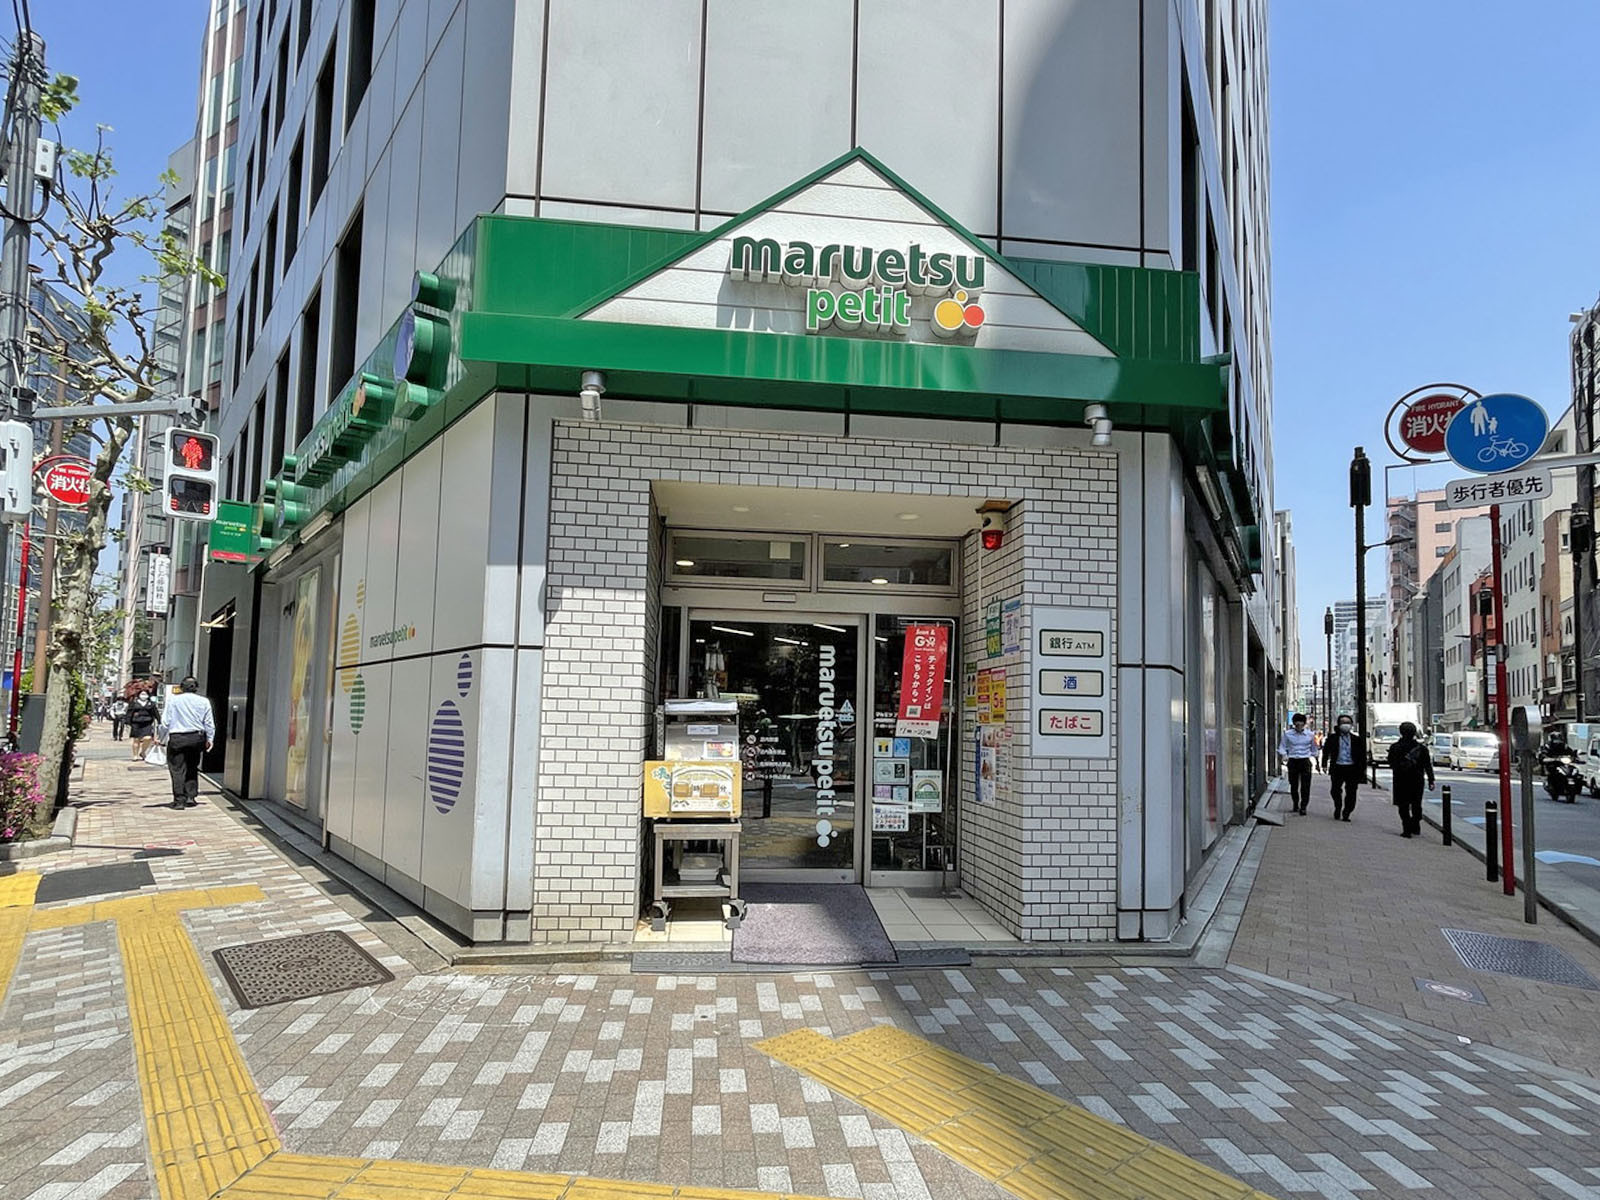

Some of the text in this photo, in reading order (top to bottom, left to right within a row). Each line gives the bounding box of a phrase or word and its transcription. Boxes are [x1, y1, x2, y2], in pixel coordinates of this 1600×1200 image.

[731, 235, 986, 289] maruetsu
[806, 286, 911, 329] petit
[1428, 400, 1459, 410] HYDRANT
[1453, 477, 1543, 503] 歩行者優先
[1049, 637, 1073, 649] 銀行
[911, 655, 921, 697] こちらから
[923, 655, 937, 709] チェックインは
[1063, 675, 1077, 690] 酒
[812, 645, 838, 816] maruetsu petit
[1050, 715, 1092, 730] たばこ
